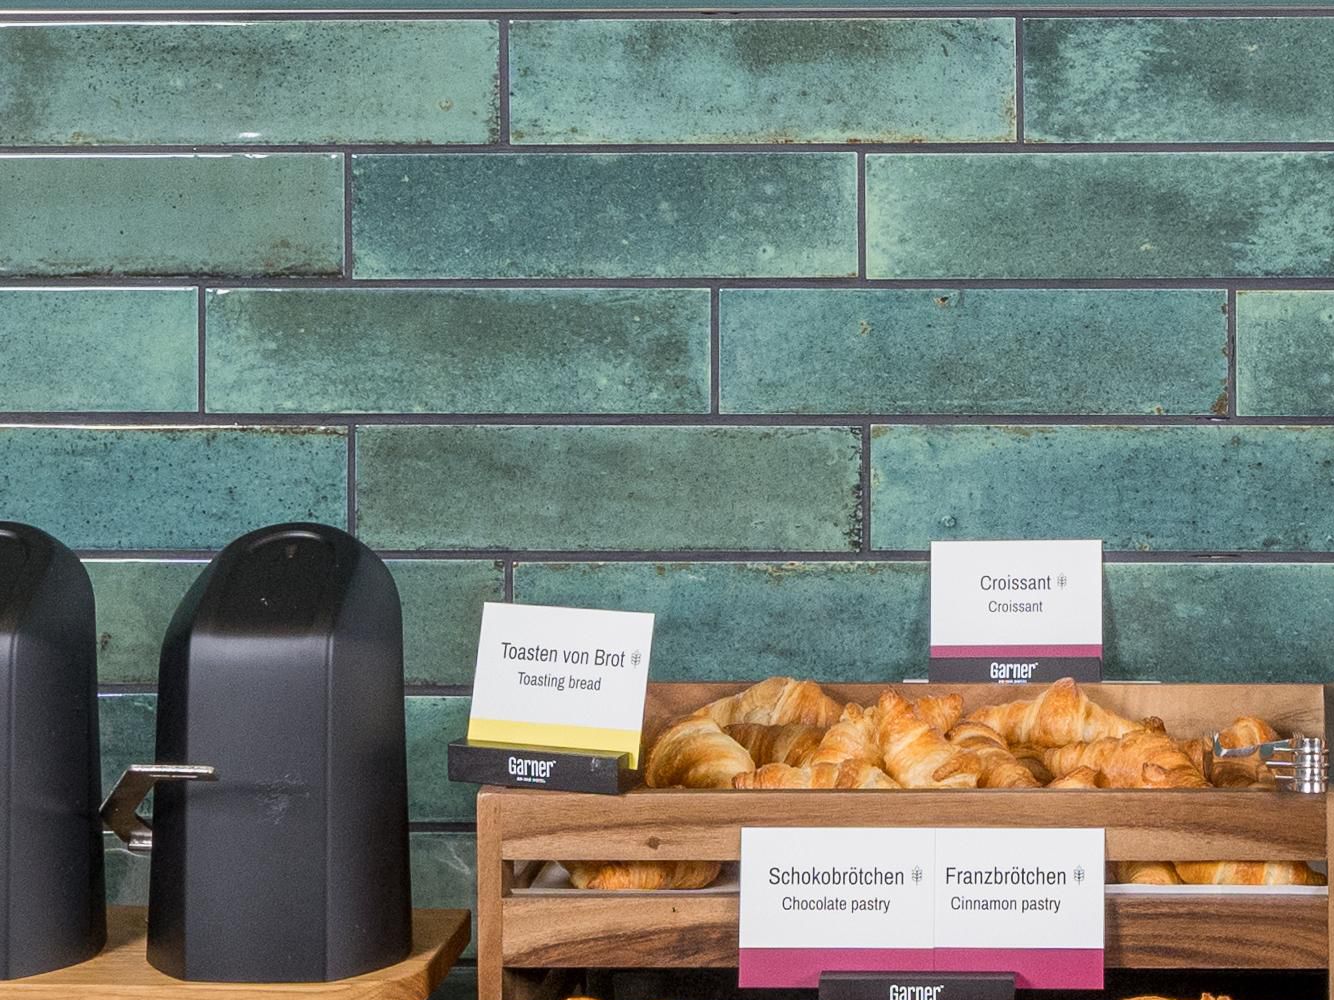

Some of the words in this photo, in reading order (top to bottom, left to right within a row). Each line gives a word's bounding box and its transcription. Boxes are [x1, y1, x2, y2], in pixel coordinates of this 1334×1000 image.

[980, 574, 1051, 591] Croissant
[988, 599, 1043, 613] Croissant
[501, 641, 558, 663] Toasten
[563, 649, 590, 665] von
[594, 648, 626, 668] Brot
[990, 662, 1036, 679] Garner
[517, 671, 566, 692] Toasting
[568, 675, 602, 691] bread
[508, 756, 554, 778] Garner
[768, 866, 904, 886] Schokobrötchen
[945, 866, 1067, 886] Franzbrötchen
[781, 896, 847, 911] Chocolate
[851, 897, 891, 914] pastry
[950, 895, 1017, 911] Cinnamon
[1021, 897, 1061, 914] pastry
